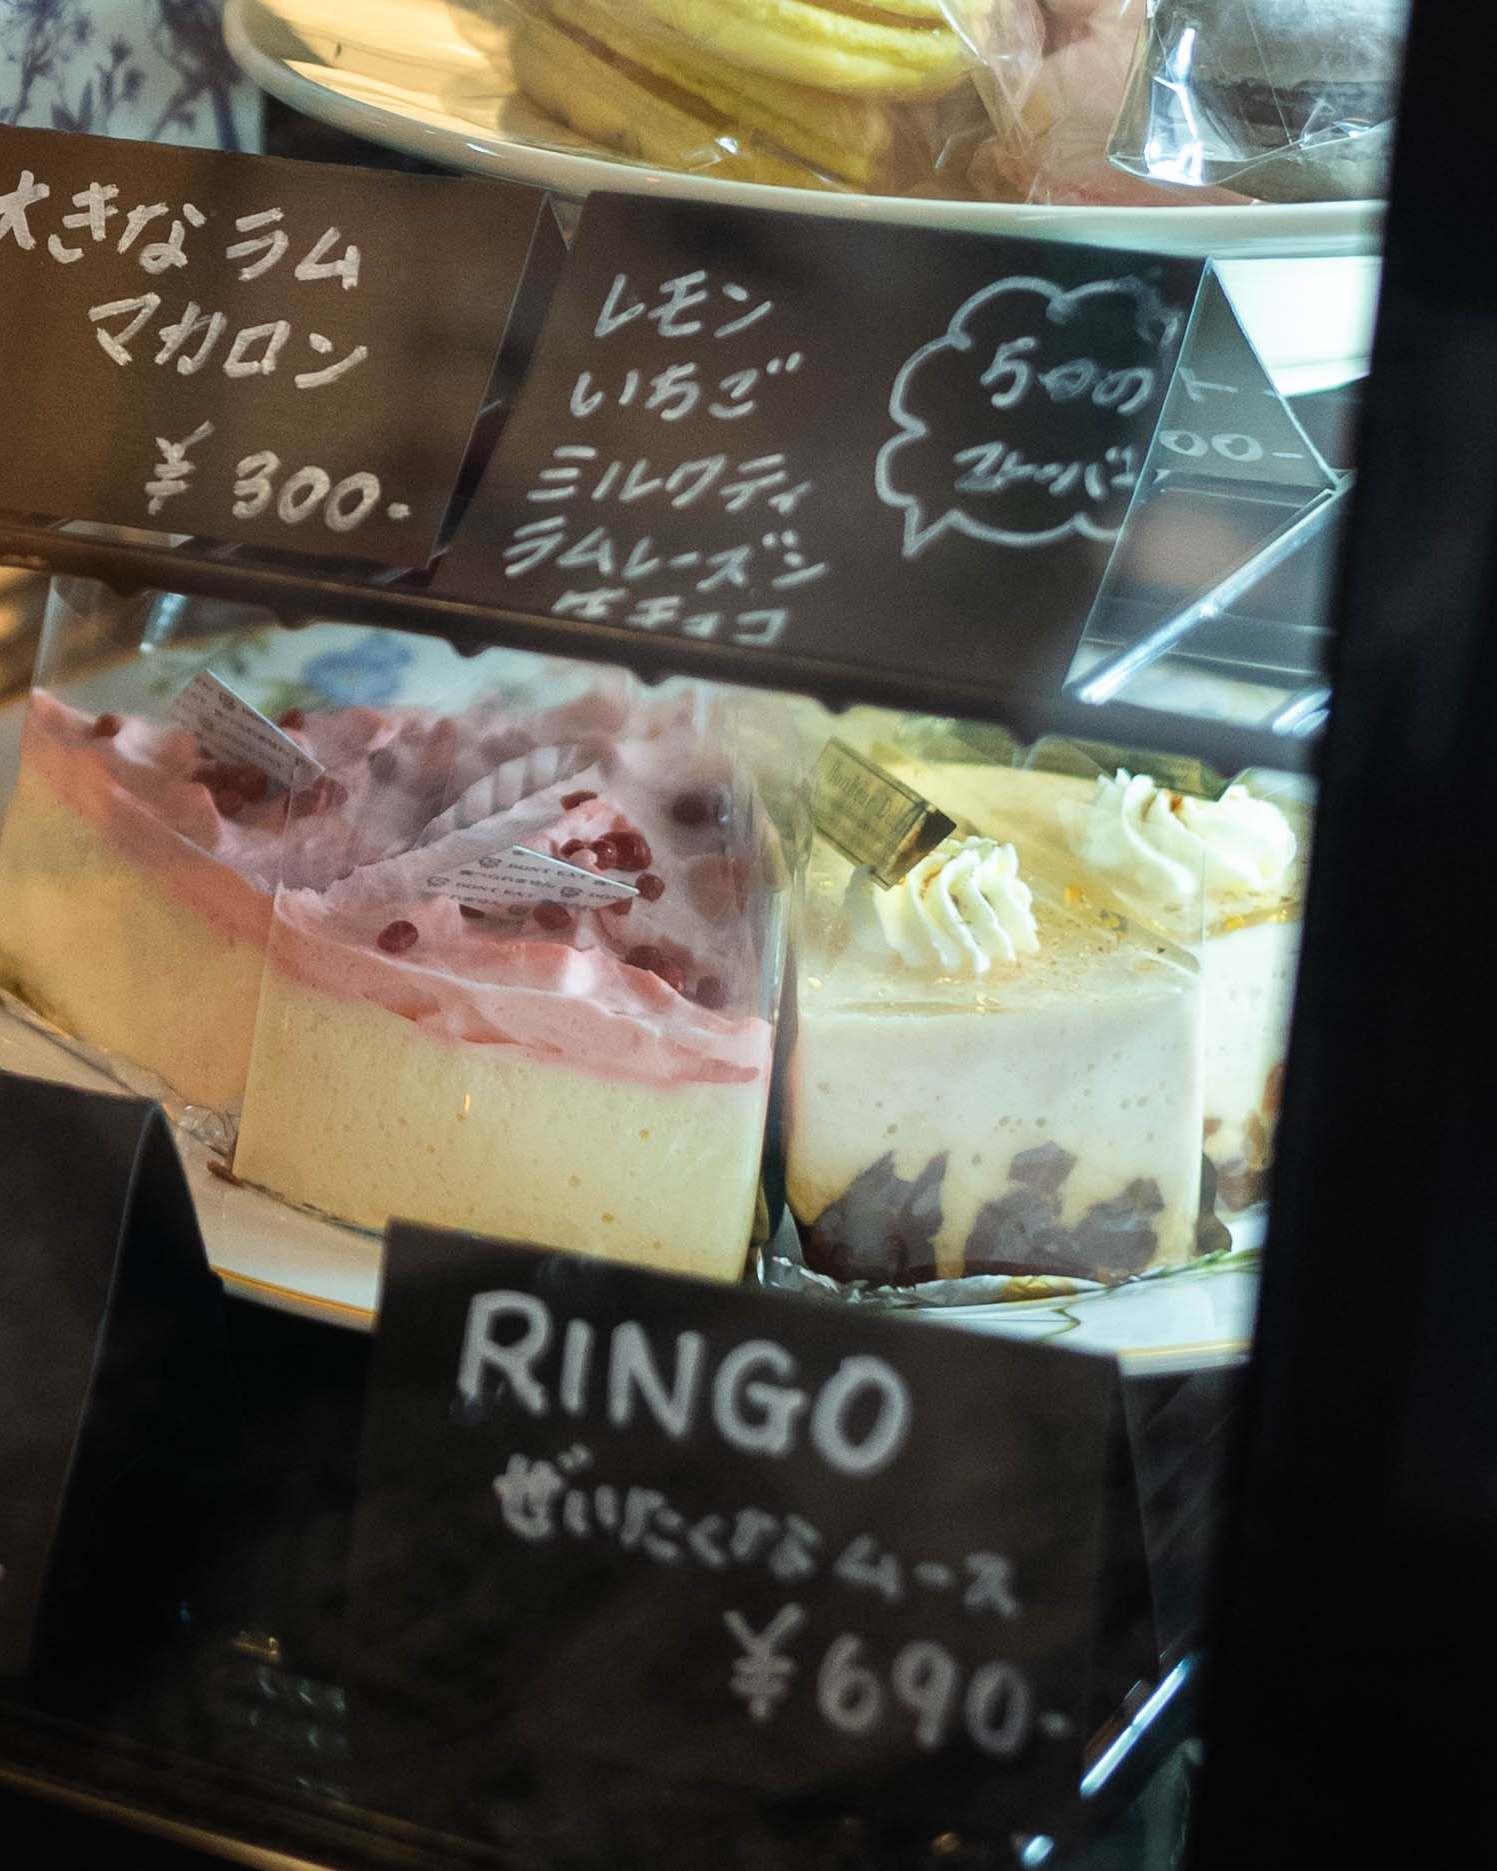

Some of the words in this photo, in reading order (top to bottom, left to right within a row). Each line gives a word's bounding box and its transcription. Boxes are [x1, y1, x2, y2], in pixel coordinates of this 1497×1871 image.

[595, 271, 771, 337] レモン
[88, 292, 367, 388] マカロン
[570, 353, 800, 421] いちご
[528, 446, 810, 513] ミルクティ
[506, 516, 825, 591] ラムレーズン
[457, 1290, 909, 1475] RINGO
